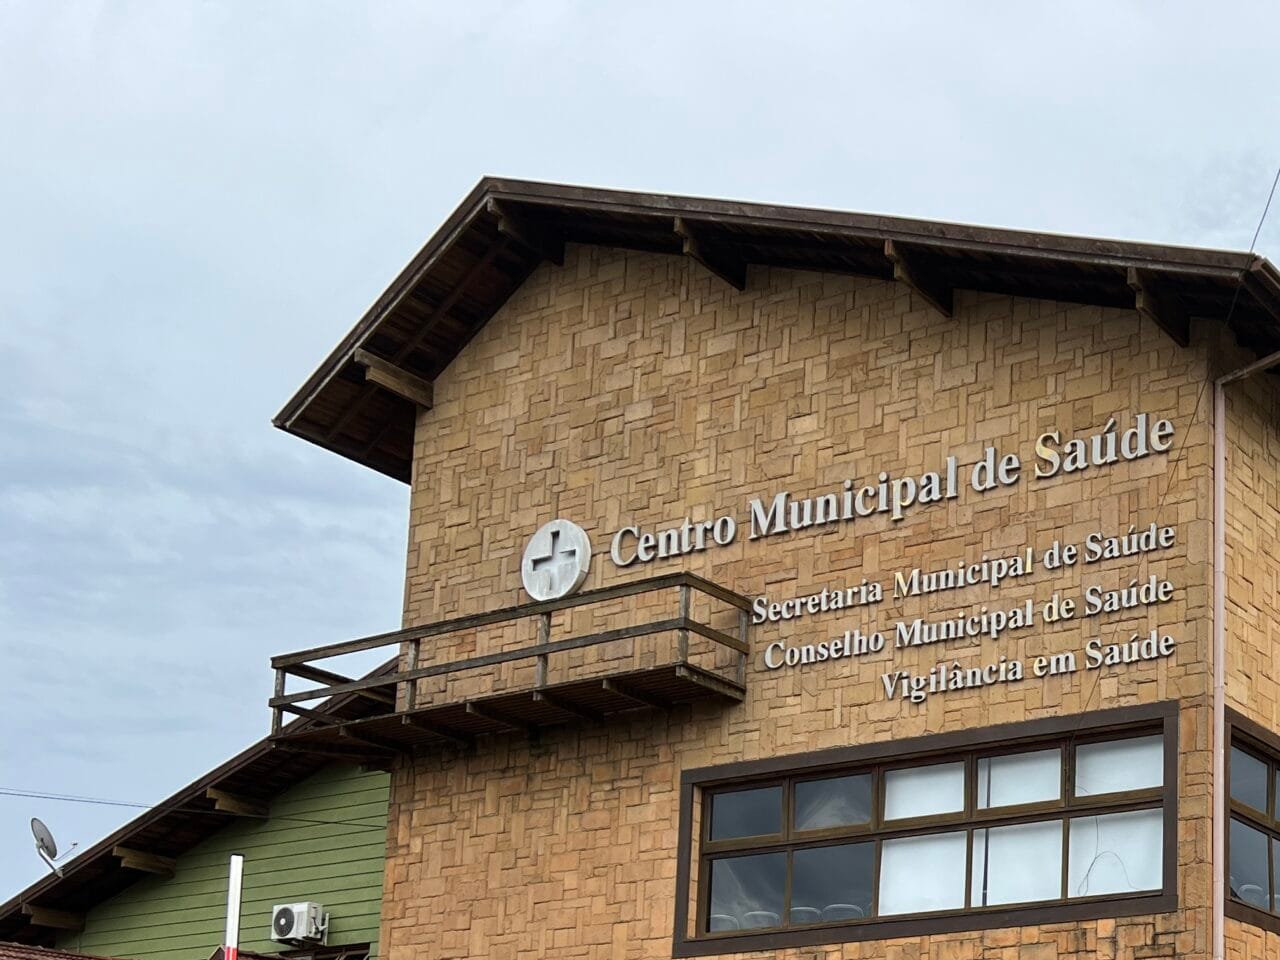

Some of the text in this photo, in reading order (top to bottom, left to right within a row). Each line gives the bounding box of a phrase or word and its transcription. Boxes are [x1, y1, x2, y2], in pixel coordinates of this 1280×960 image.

[610, 413, 1176, 568] Centro Municipal de Saúde
[751, 523, 1175, 625] Secretaria Municipal de Saúde
[764, 576, 1174, 671] Conselho Municipal de Saúde
[879, 628, 1176, 705] Vigilância em Saúde
